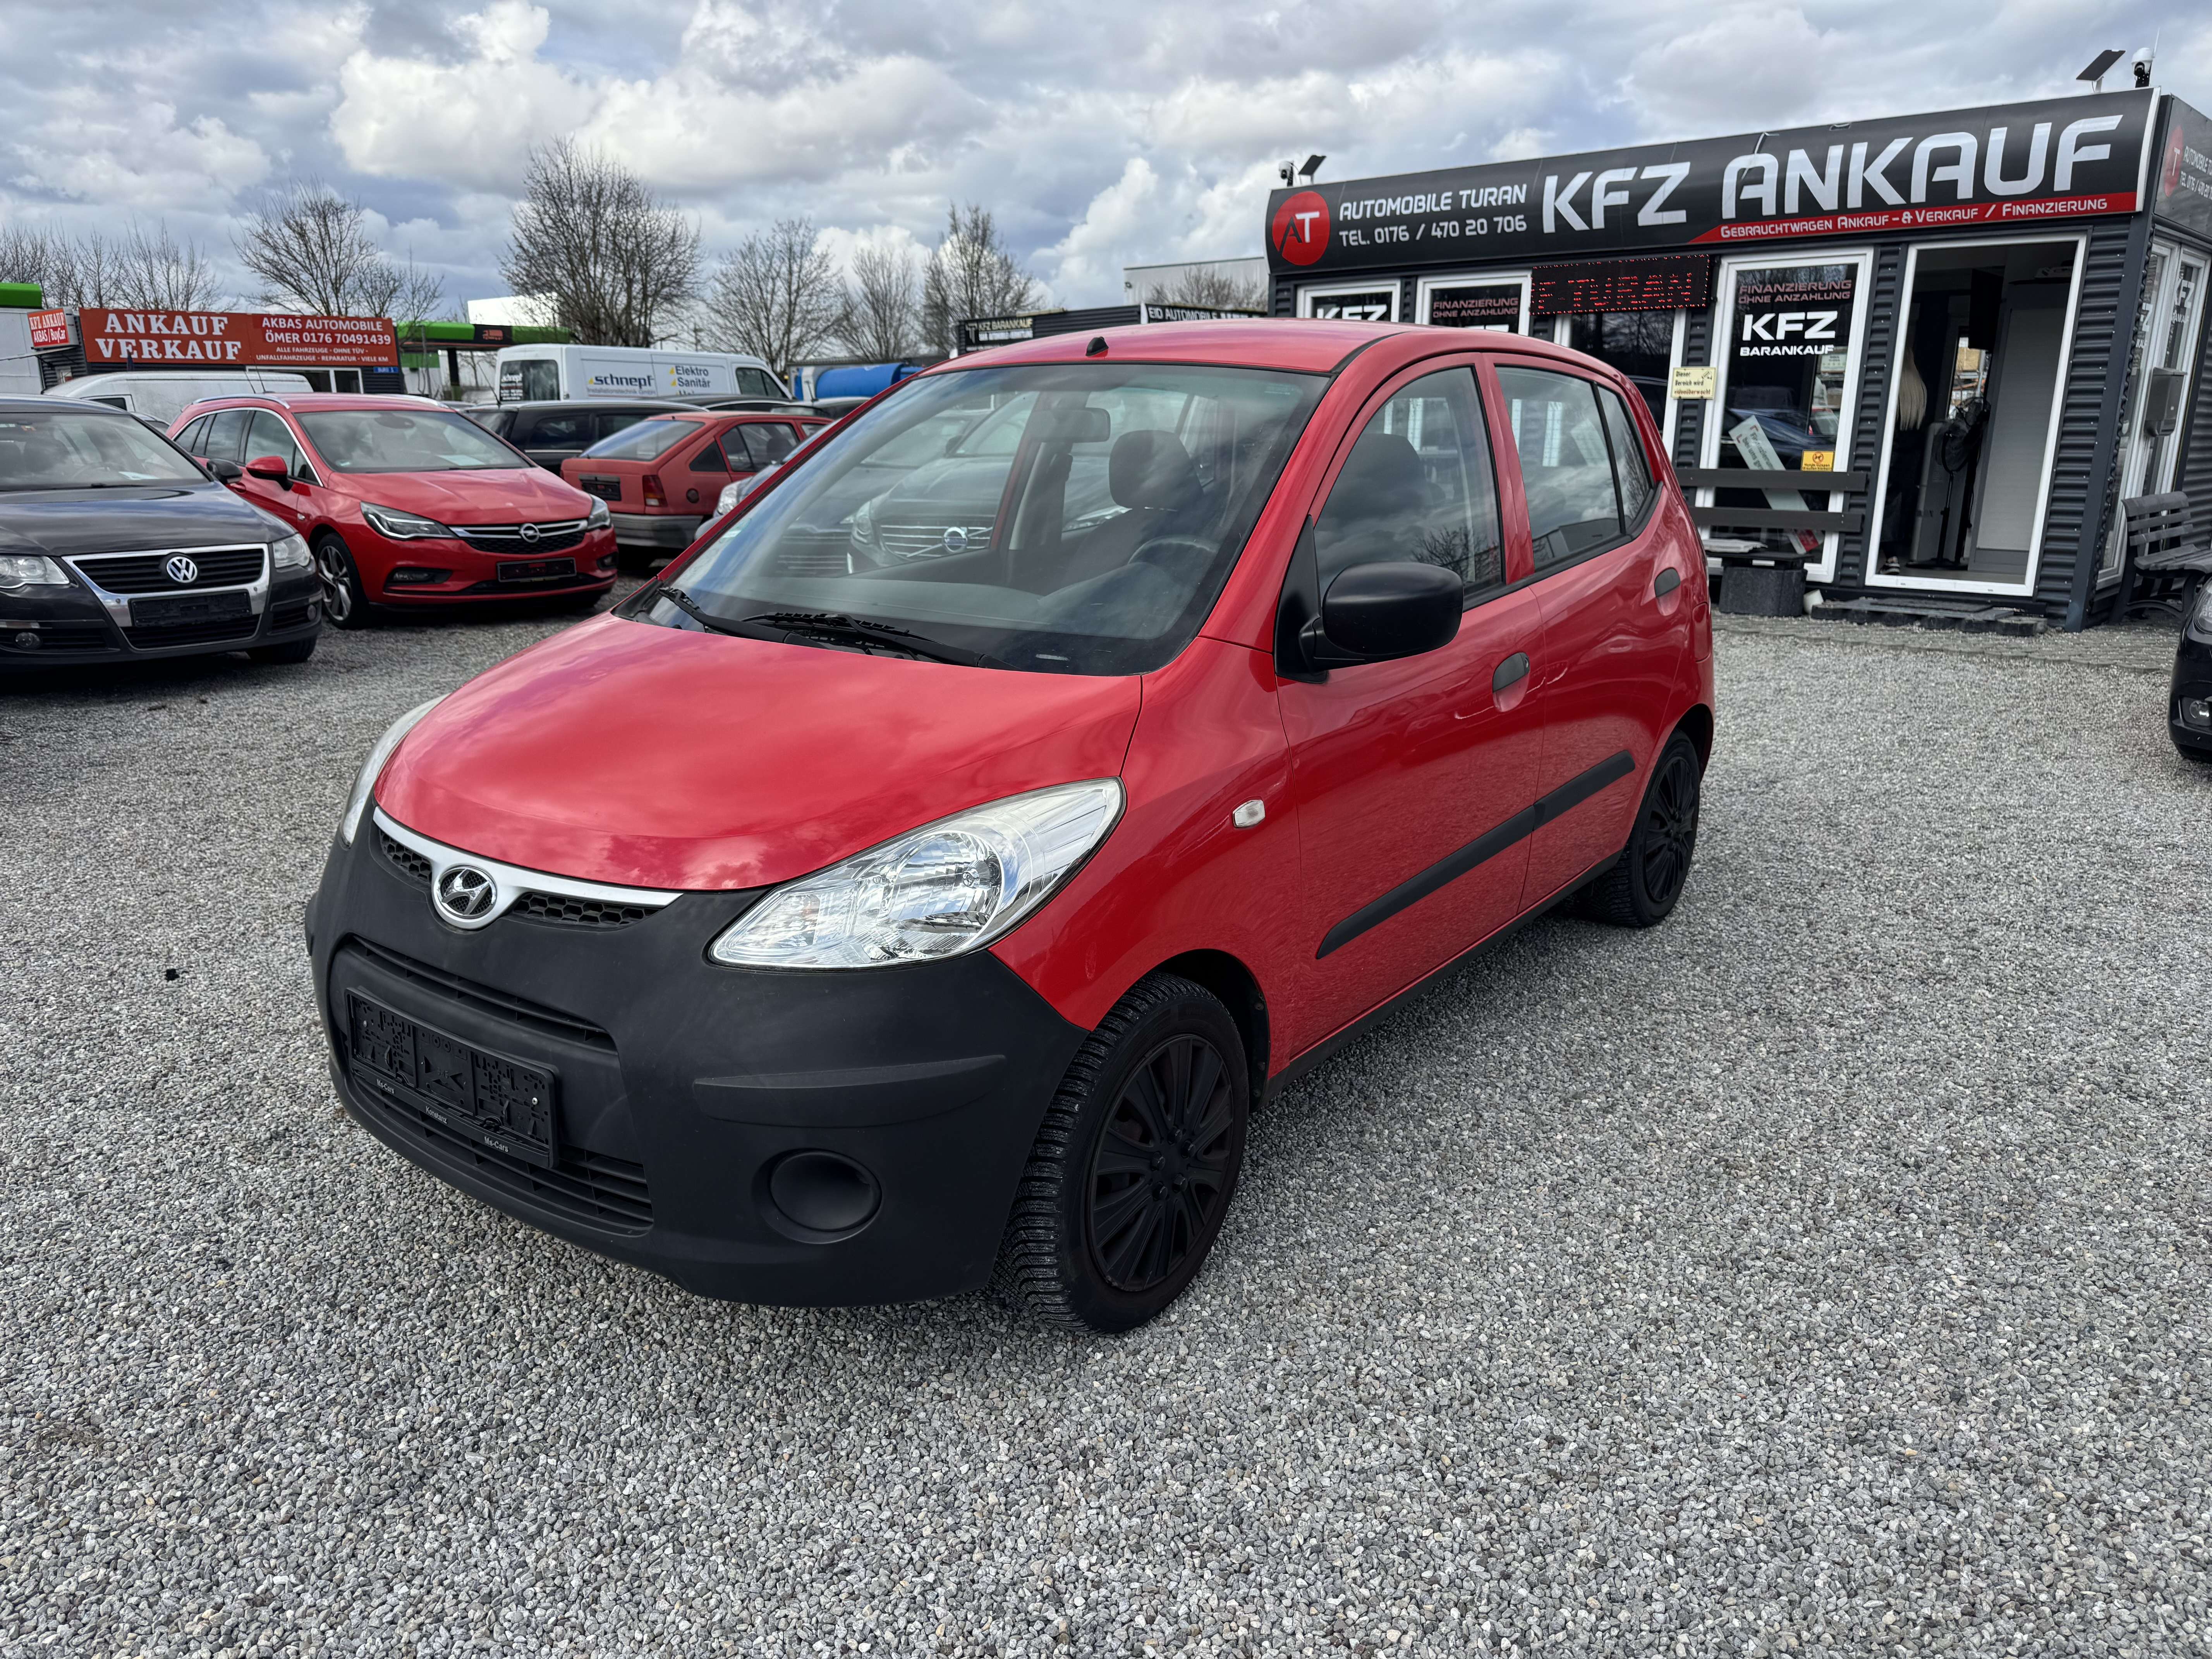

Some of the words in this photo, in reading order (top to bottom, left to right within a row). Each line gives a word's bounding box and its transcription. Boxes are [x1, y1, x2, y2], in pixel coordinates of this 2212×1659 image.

[1542, 161, 1691, 234] KFZ
[1722, 114, 2123, 219] ANKAUF
[1339, 191, 1453, 221] AUTOMOBILE
[1459, 184, 1527, 210] TURAN
[1838, 215, 1889, 229] ANKAUF
[1985, 204, 1996, 218] /
[1339, 230, 1370, 247] TEL.
[1375, 225, 1409, 244] 0176
[1415, 223, 1425, 240] /
[1431, 221, 1460, 239] 470
[1465, 218, 1487, 236] 20
[1493, 215, 1527, 234] 706
[1568, 273, 1692, 307] TURAN
[1739, 280, 1851, 294] FINANZIERUNG
[1433, 298, 1518, 309] FINANZIERUNG
[1738, 295, 1771, 304] OHNE
[1774, 291, 1851, 303] ANZAHLUNG
[1460, 308, 1518, 317] ANZAHLUNG
[29, 316, 42, 330] KFZ
[42, 312, 64, 328] ANKAUF
[104, 313, 228, 335] ANKAUF
[262, 317, 302, 329] AKBAS
[306, 319, 383, 331] AUTOMOBILE
[1743, 311, 1838, 341] KFZ
[266, 330, 300, 343] ÖMER
[303, 332, 332, 343] 0176
[336, 333, 391, 345] 70491439
[95, 338, 241, 360] VERKAUF
[1740, 344, 1834, 356] BARANKAUF
[675, 366, 709, 376] Elektro
[594, 374, 654, 389] schnepf
[677, 377, 711, 388] Sanitär
[377, 1079, 395, 1094] Ms-Cars
[426, 1106, 447, 1124] Konstanz
[484, 1136, 508, 1152] Ms-Cars
